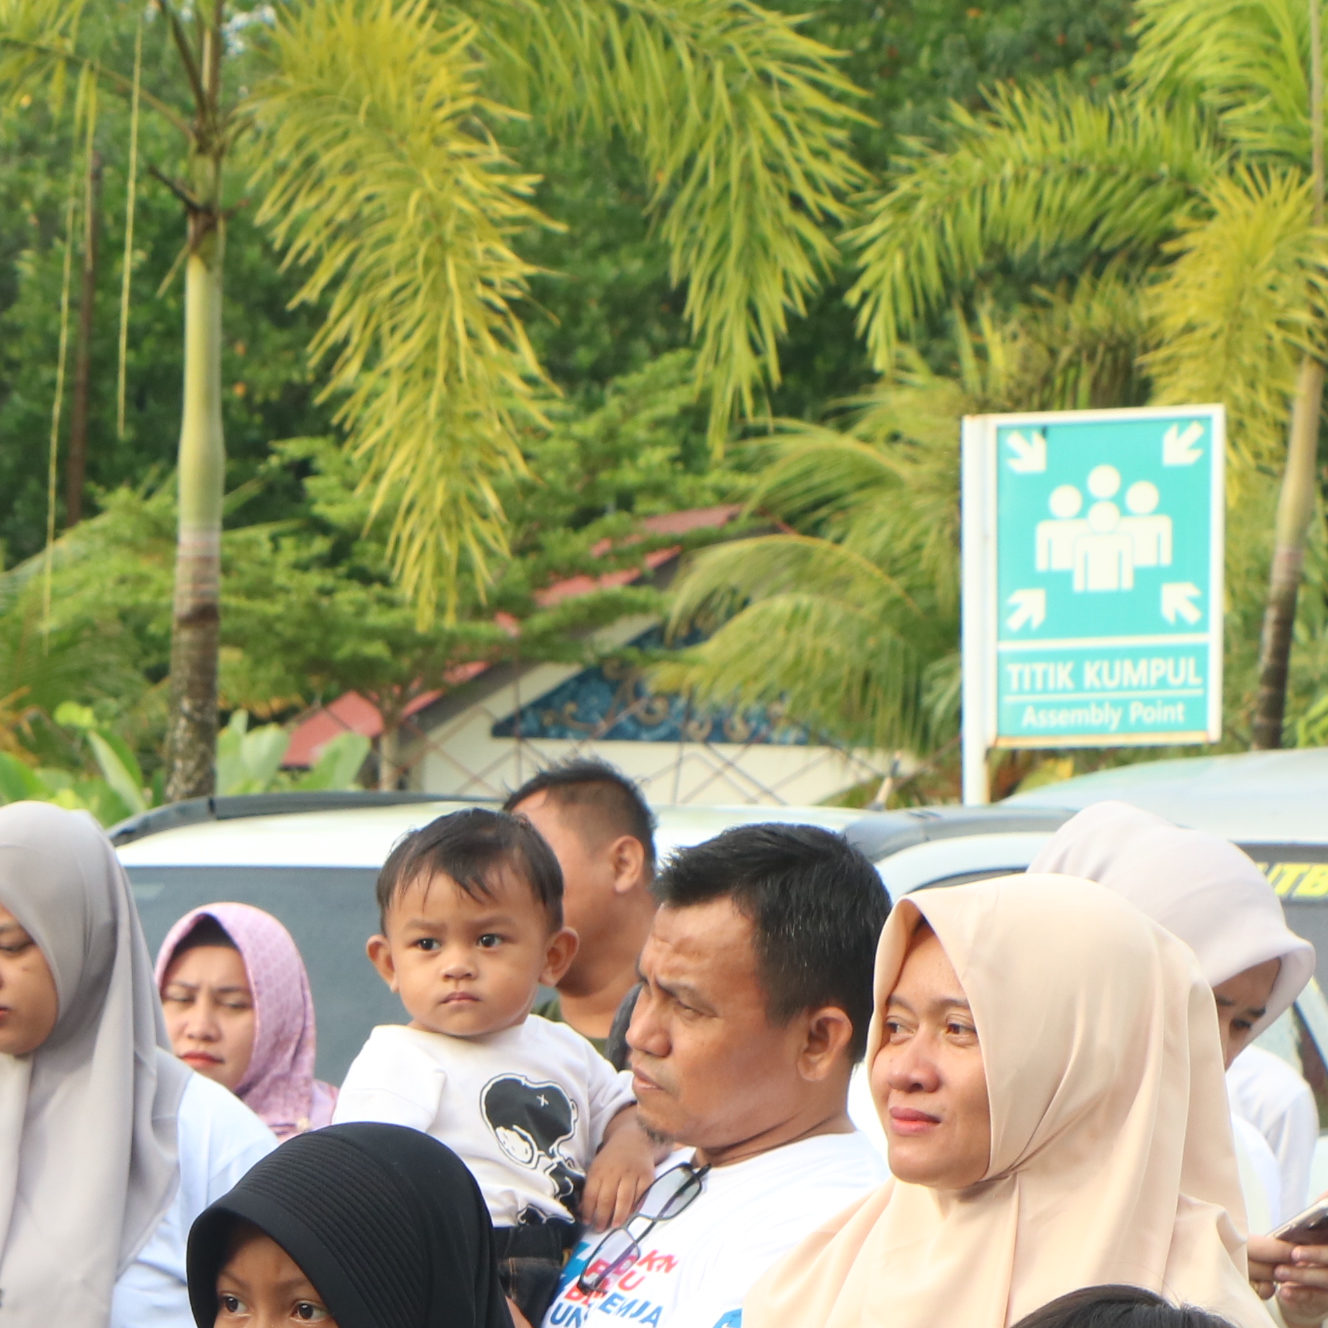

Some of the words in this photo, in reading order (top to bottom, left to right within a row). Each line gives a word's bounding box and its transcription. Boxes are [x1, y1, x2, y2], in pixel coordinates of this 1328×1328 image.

[1007, 662, 1075, 692] TITIK
[1084, 656, 1203, 688] KUMPUL
[1022, 703, 1122, 731] Assembly
[1129, 700, 1185, 726] Point
